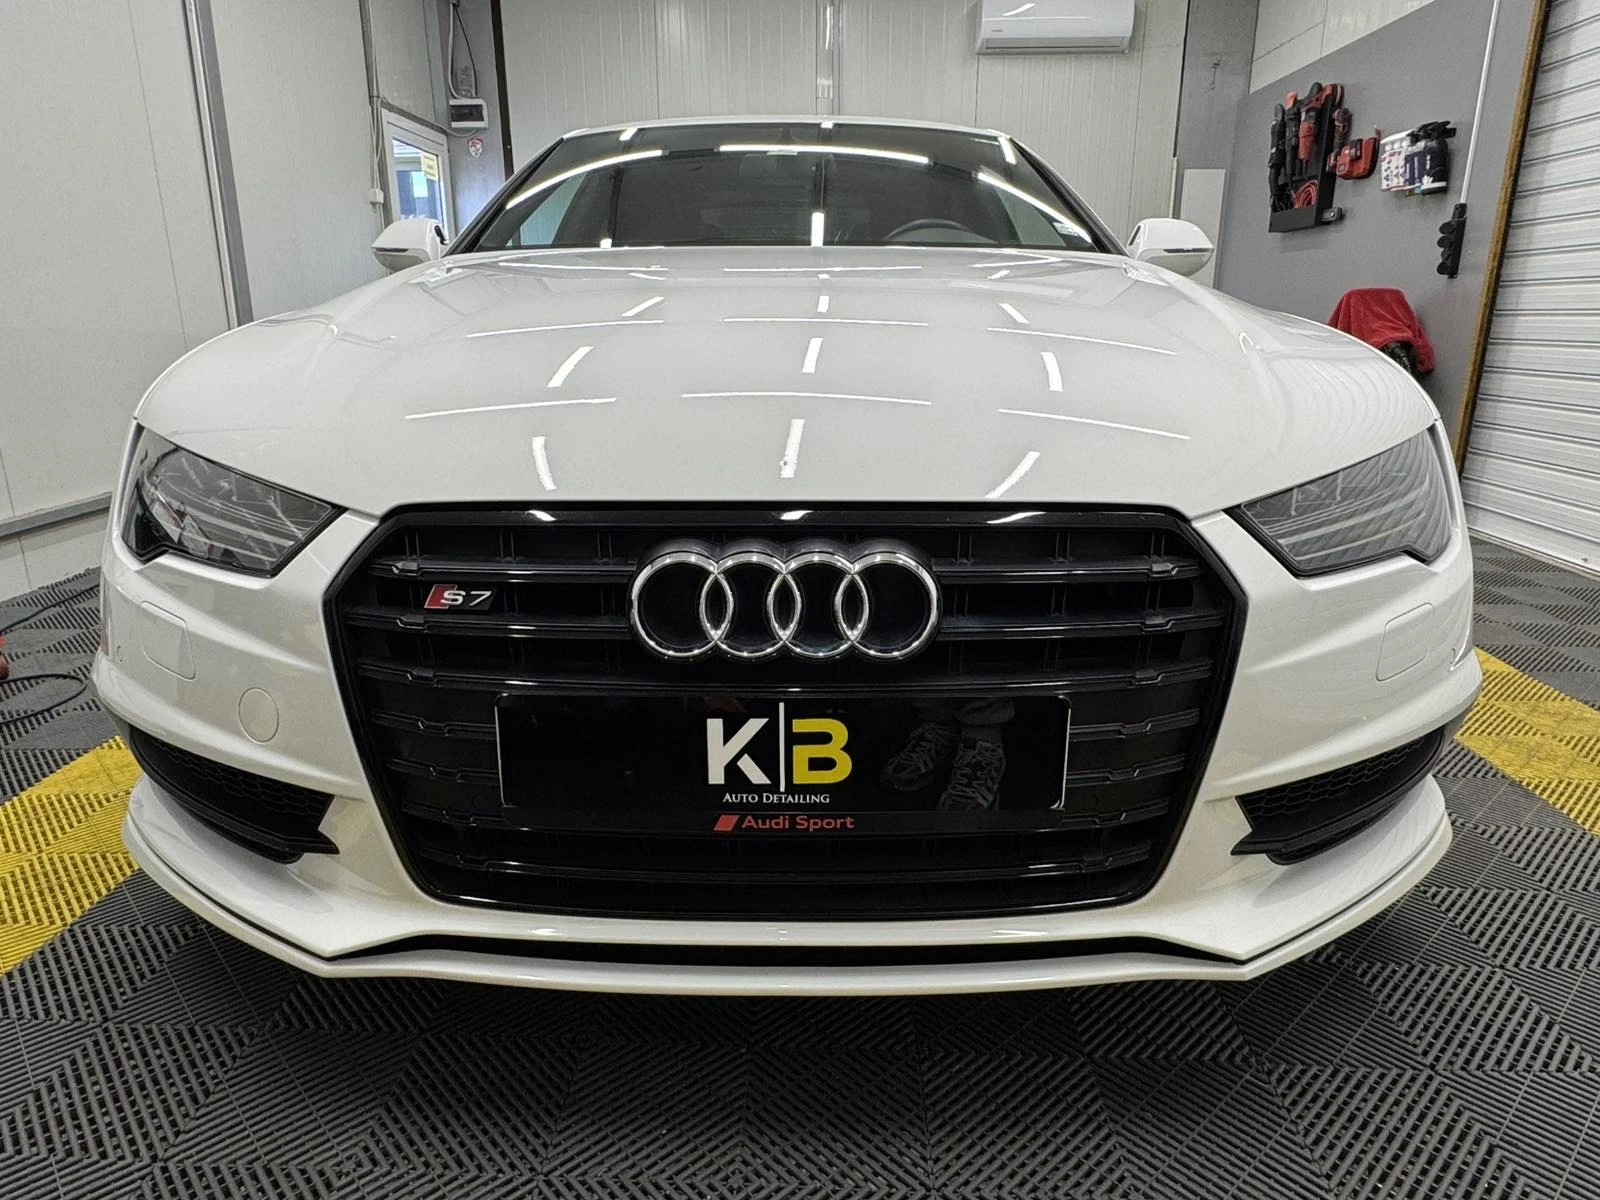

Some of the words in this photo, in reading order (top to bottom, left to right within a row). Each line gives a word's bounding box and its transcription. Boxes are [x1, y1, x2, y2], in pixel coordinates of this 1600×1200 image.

[440, 590, 492, 606] S7
[723, 792, 759, 804] AUTO
[762, 792, 830, 804] DETAILING
[741, 815, 789, 829] Audi
[795, 815, 855, 832] Sport
